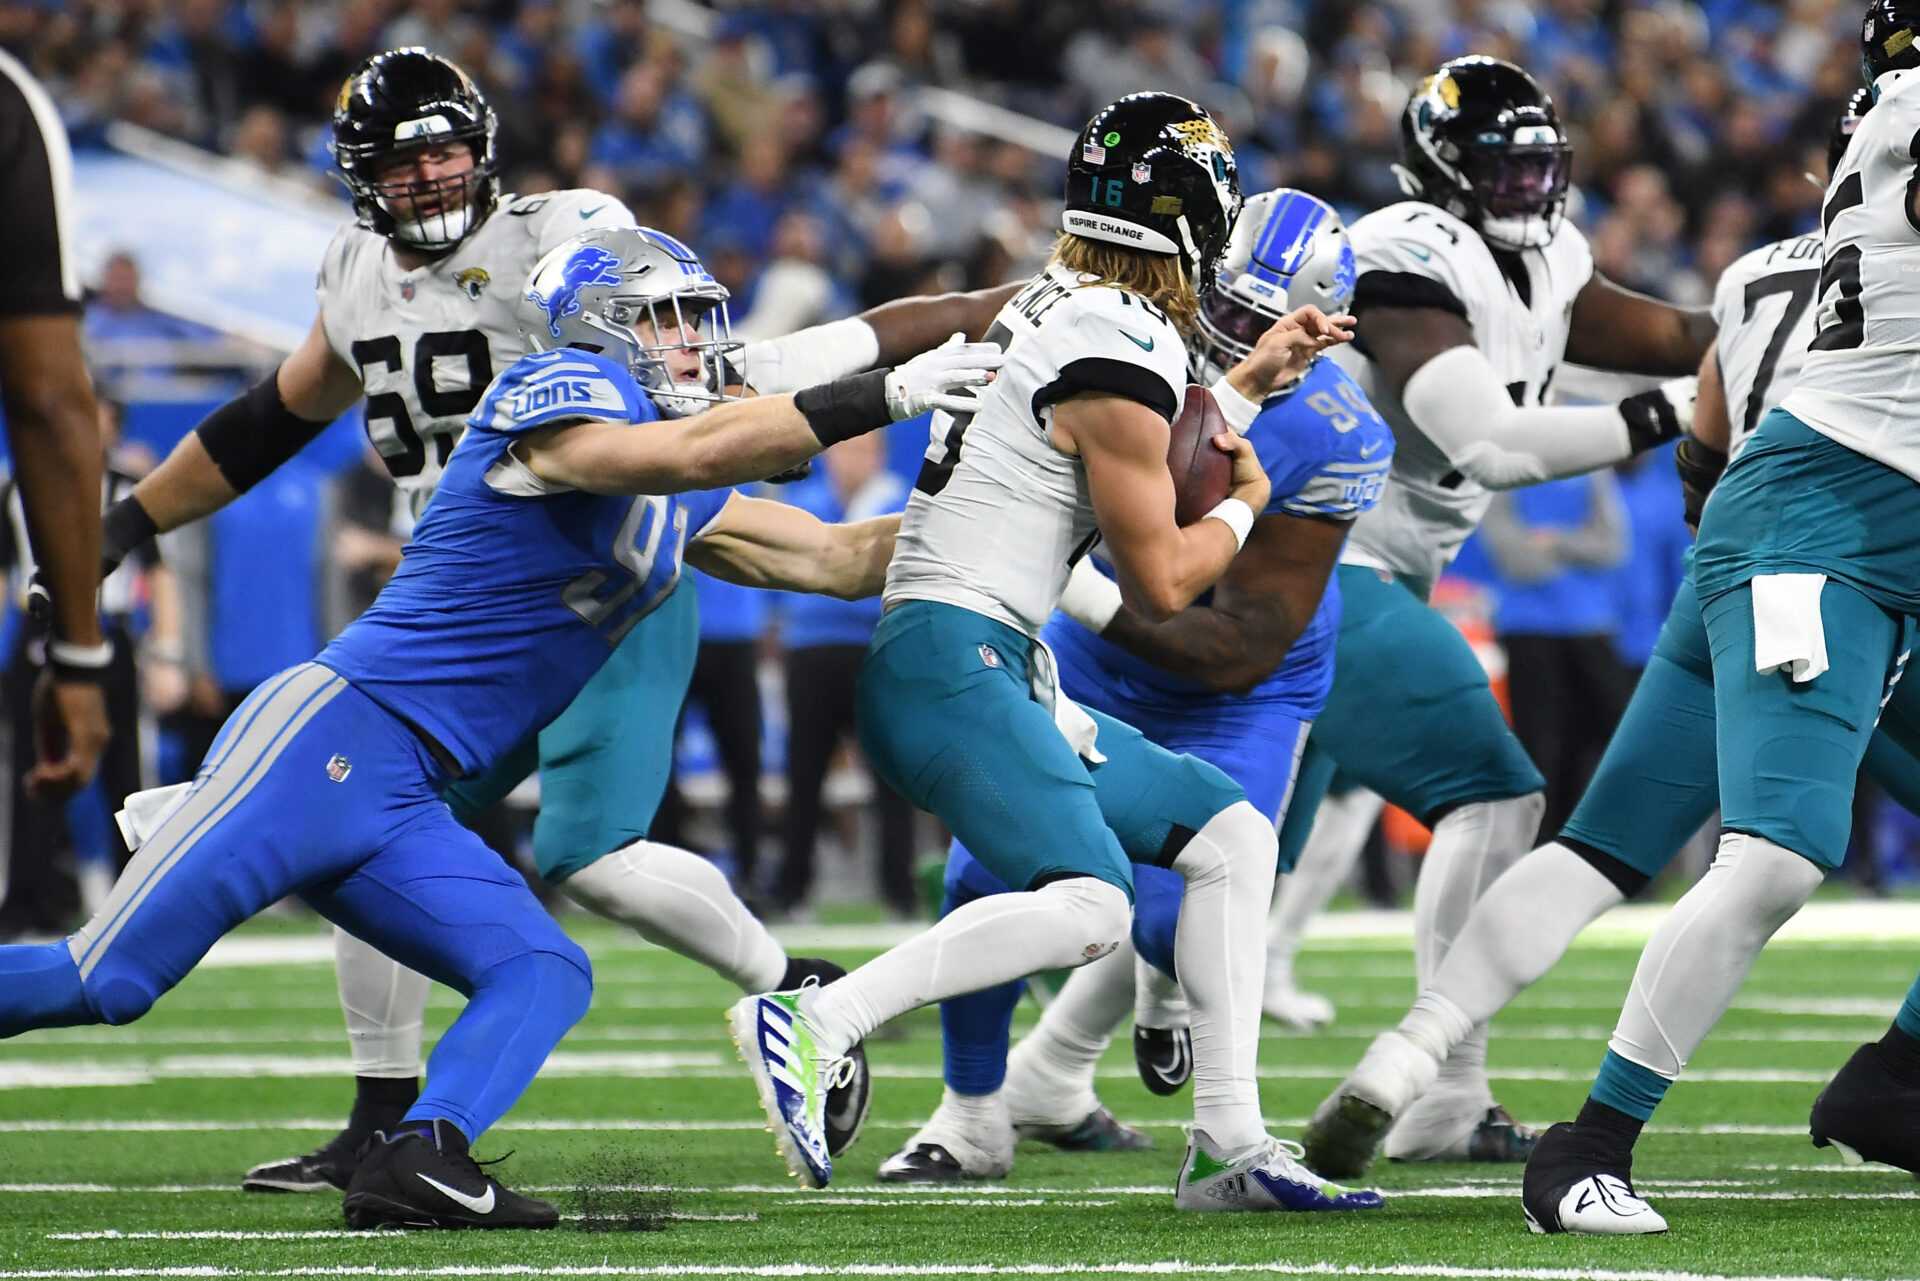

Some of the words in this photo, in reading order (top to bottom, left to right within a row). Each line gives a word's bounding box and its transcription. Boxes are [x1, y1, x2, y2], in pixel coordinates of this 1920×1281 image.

[1090, 176, 1123, 207] 16
[1100, 222, 1144, 240] CHANGE
[352, 328, 493, 477] 69
[513, 381, 592, 420] LIONS
